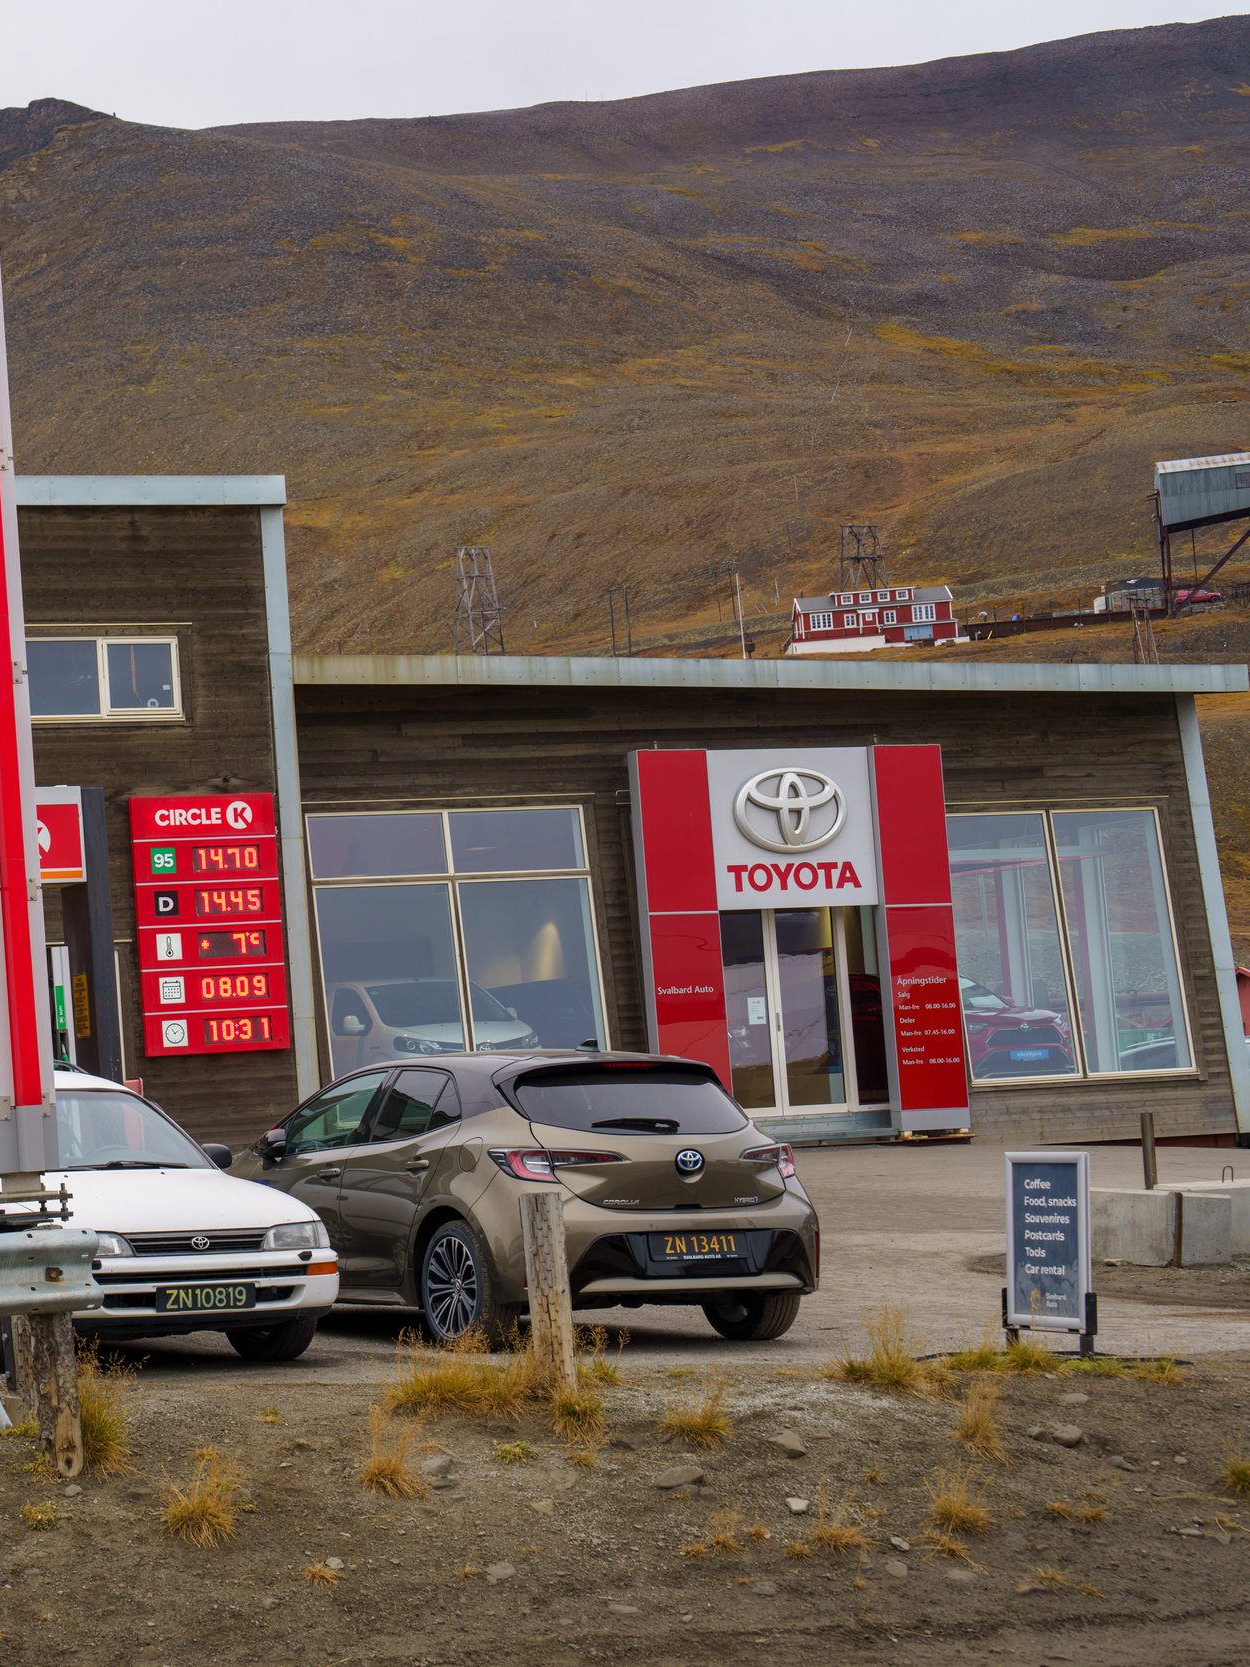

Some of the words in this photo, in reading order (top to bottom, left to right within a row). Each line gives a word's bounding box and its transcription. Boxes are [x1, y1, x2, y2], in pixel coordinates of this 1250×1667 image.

[154, 807, 223, 827] CIRCLE
[230, 804, 252, 827] K
[153, 853, 175, 868] 95
[198, 847, 258, 870] 14.70
[726, 861, 862, 893] TOYOTA
[158, 896, 175, 912] D
[201, 889, 262, 913] 14.45
[201, 975, 267, 999] 08.09
[897, 975, 947, 987] Åpningstider
[657, 985, 693, 995] Svalbard
[694, 985, 714, 994] Auto
[897, 991, 910, 999] Salg
[925, 1002, 956, 1010] 08.00-16.00
[1024, 1178, 1052, 1190] Coffee
[1024, 1195, 1047, 1208] Food,
[1047, 1196, 1077, 1207] snacks
[1024, 1212, 1070, 1224] Souvenires
[1024, 1230, 1066, 1242] Postcards
[664, 1236, 687, 1255] ZN
[689, 1235, 737, 1253] 13411
[1024, 1246, 1047, 1258] Tools
[1024, 1263, 1040, 1274] Car
[1040, 1264, 1066, 1275] rental
